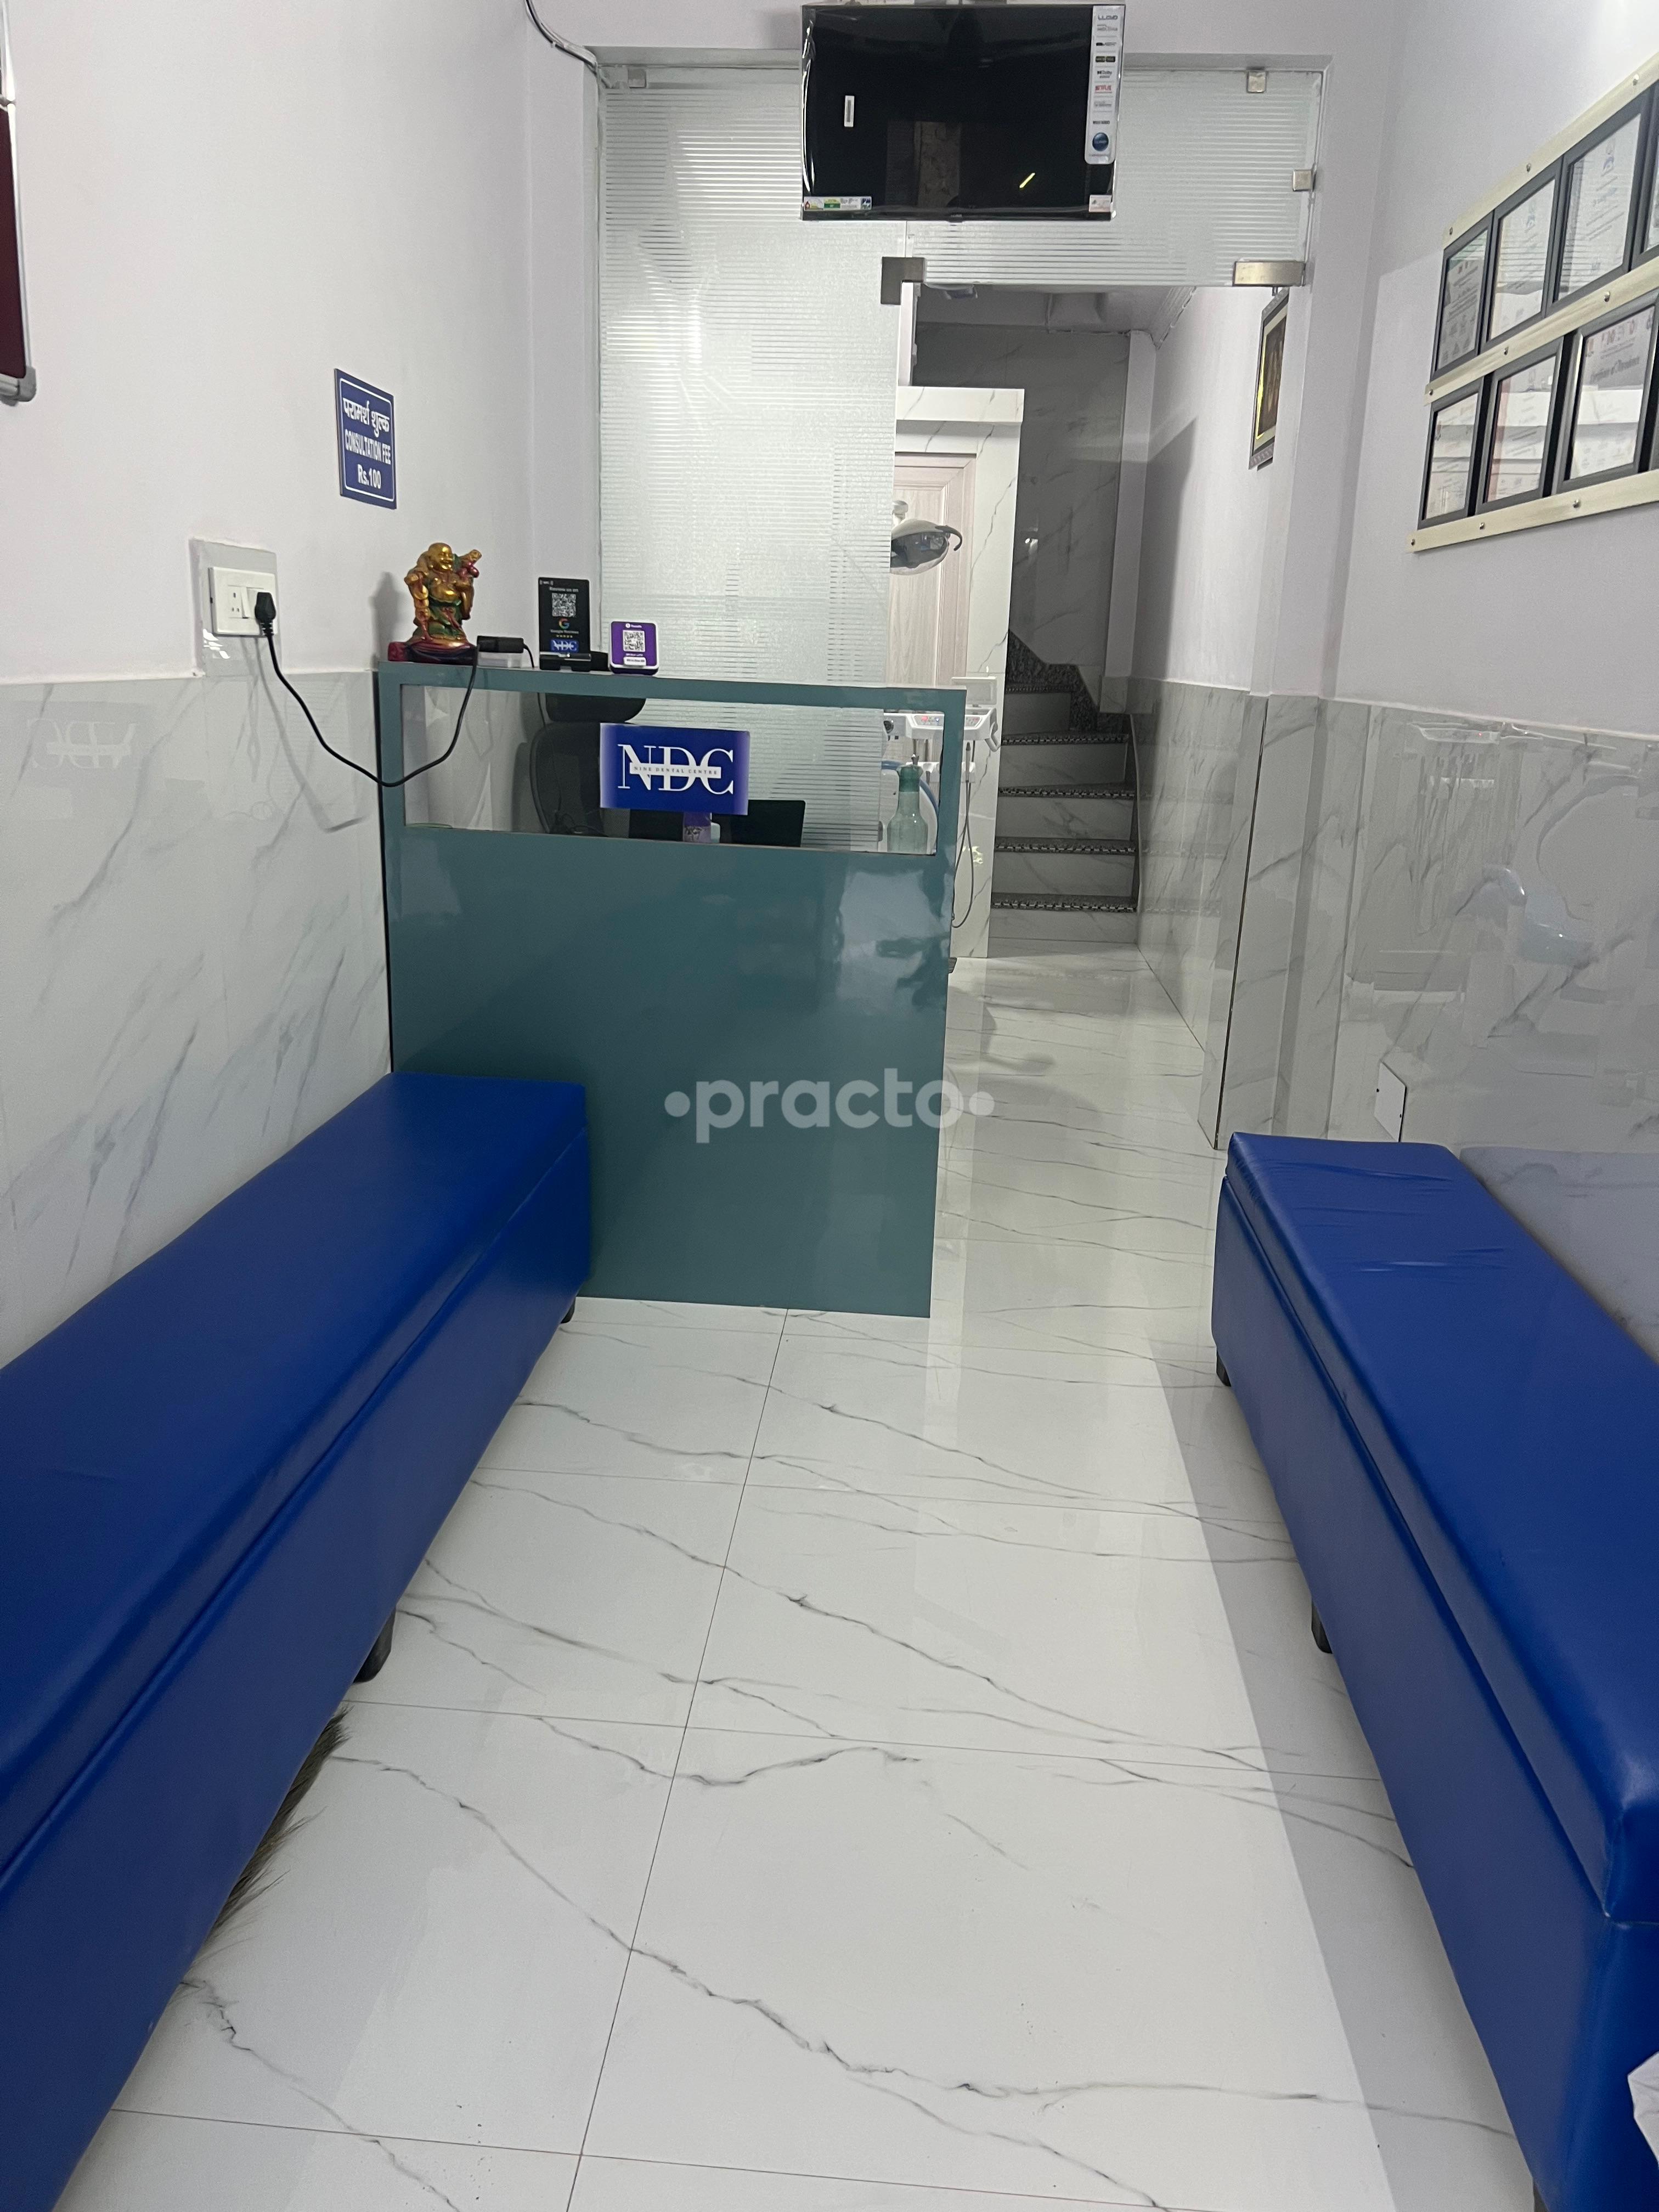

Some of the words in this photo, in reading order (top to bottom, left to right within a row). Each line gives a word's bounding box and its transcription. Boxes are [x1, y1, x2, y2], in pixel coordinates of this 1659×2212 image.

[342, 397, 370, 426] परामर्श
[371, 411, 390, 438] शुल्क
[345, 428, 382, 462] CONSULTATION
[382, 442, 391, 465] FEE
[617, 744, 734, 795] NDC
